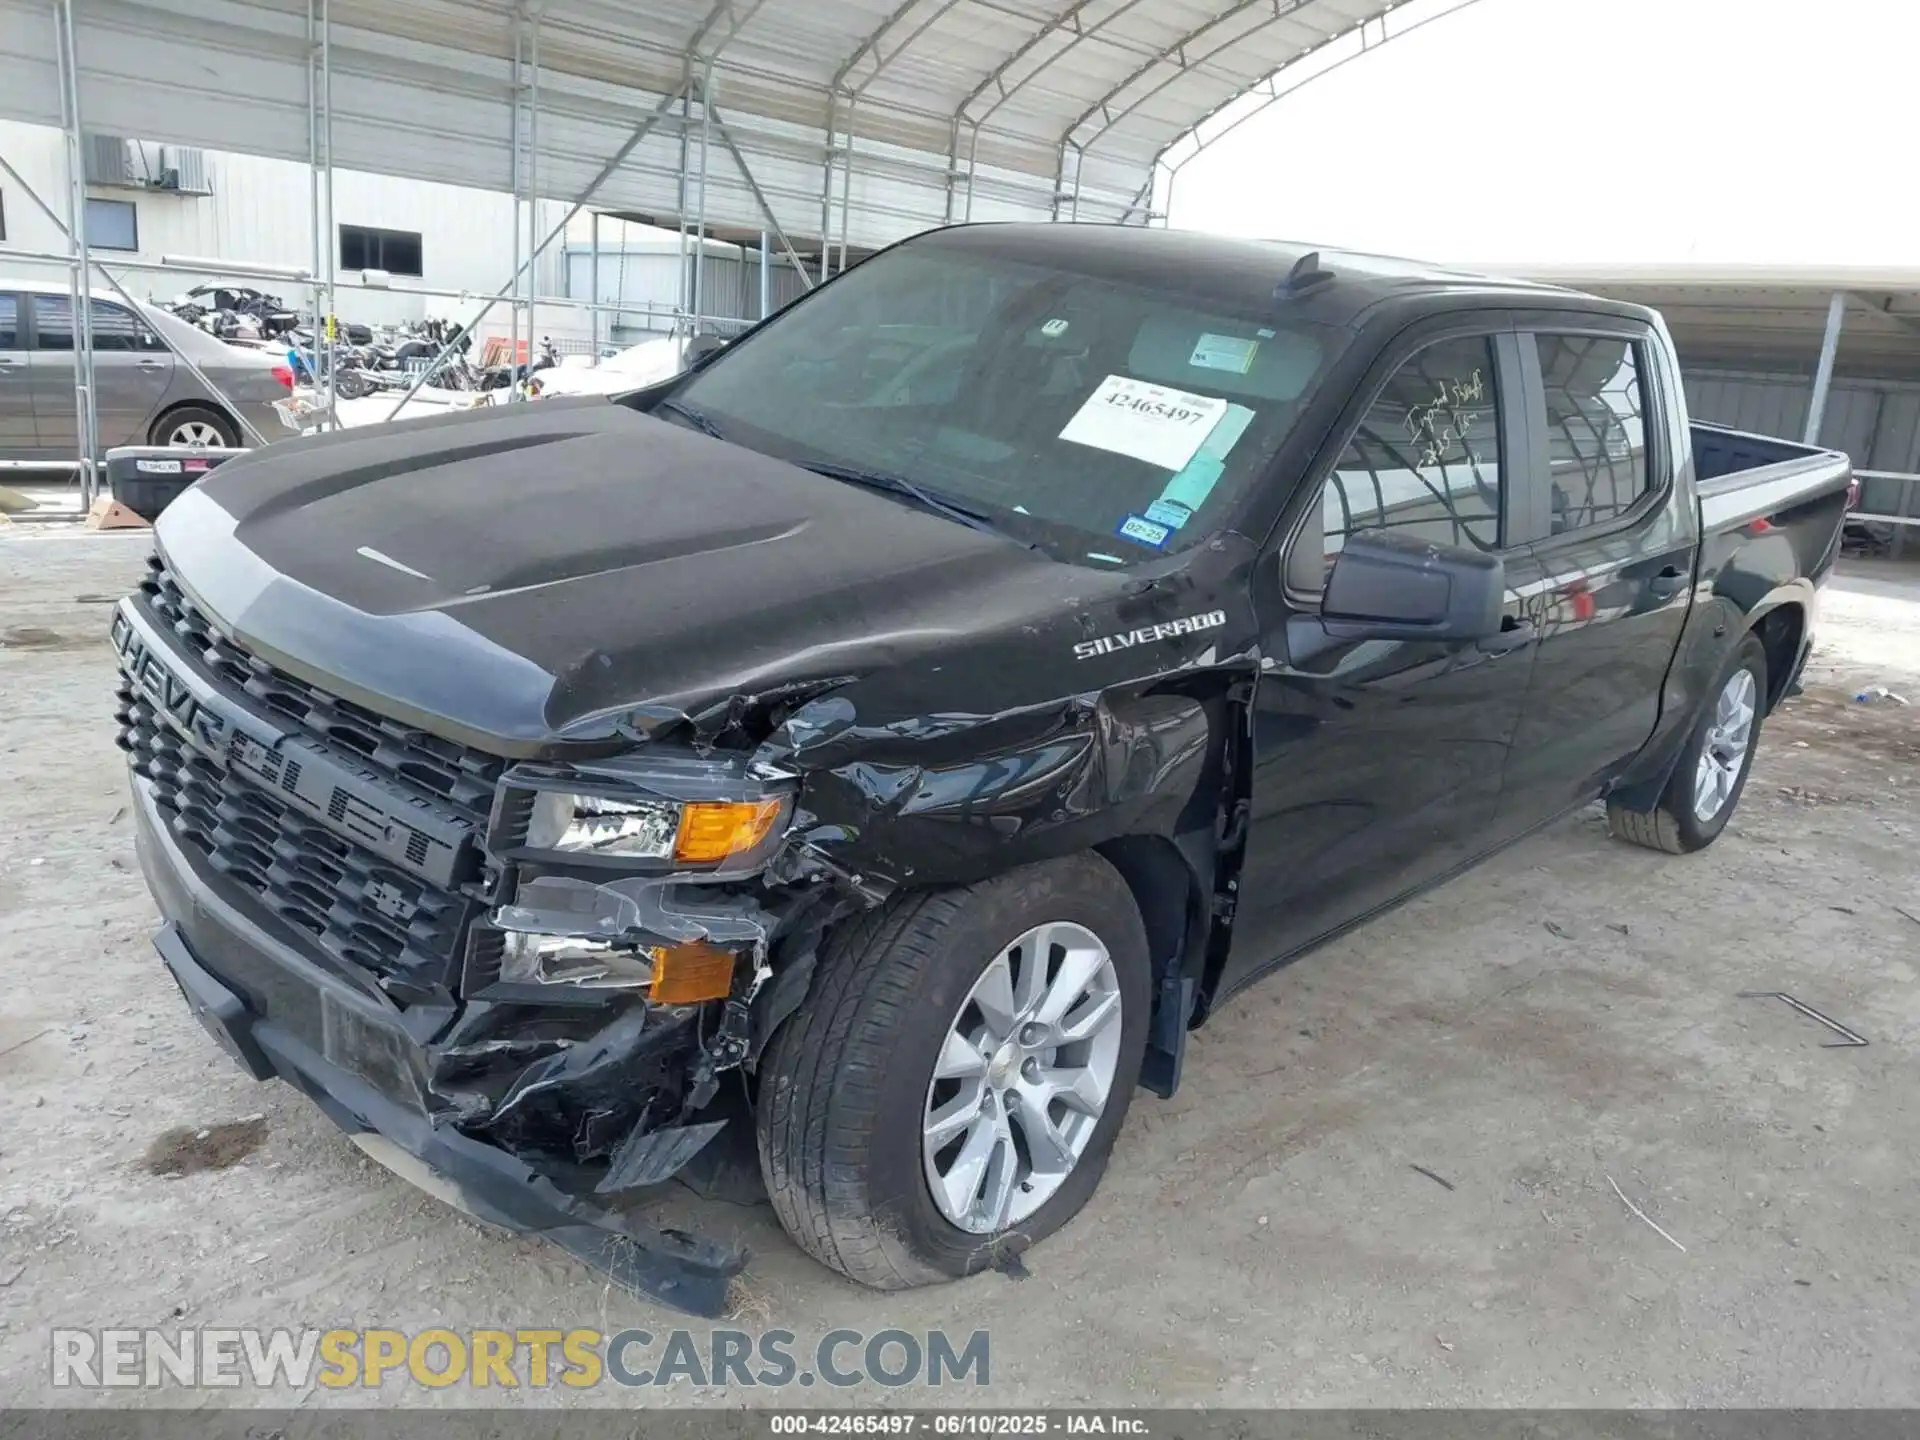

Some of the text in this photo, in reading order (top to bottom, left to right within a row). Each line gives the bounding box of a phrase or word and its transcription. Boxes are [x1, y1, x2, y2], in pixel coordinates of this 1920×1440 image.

[1105, 392, 1205, 425] 42465497
[1072, 609, 1227, 660] SILVERADO
[111, 610, 455, 871] CHEVROLET
